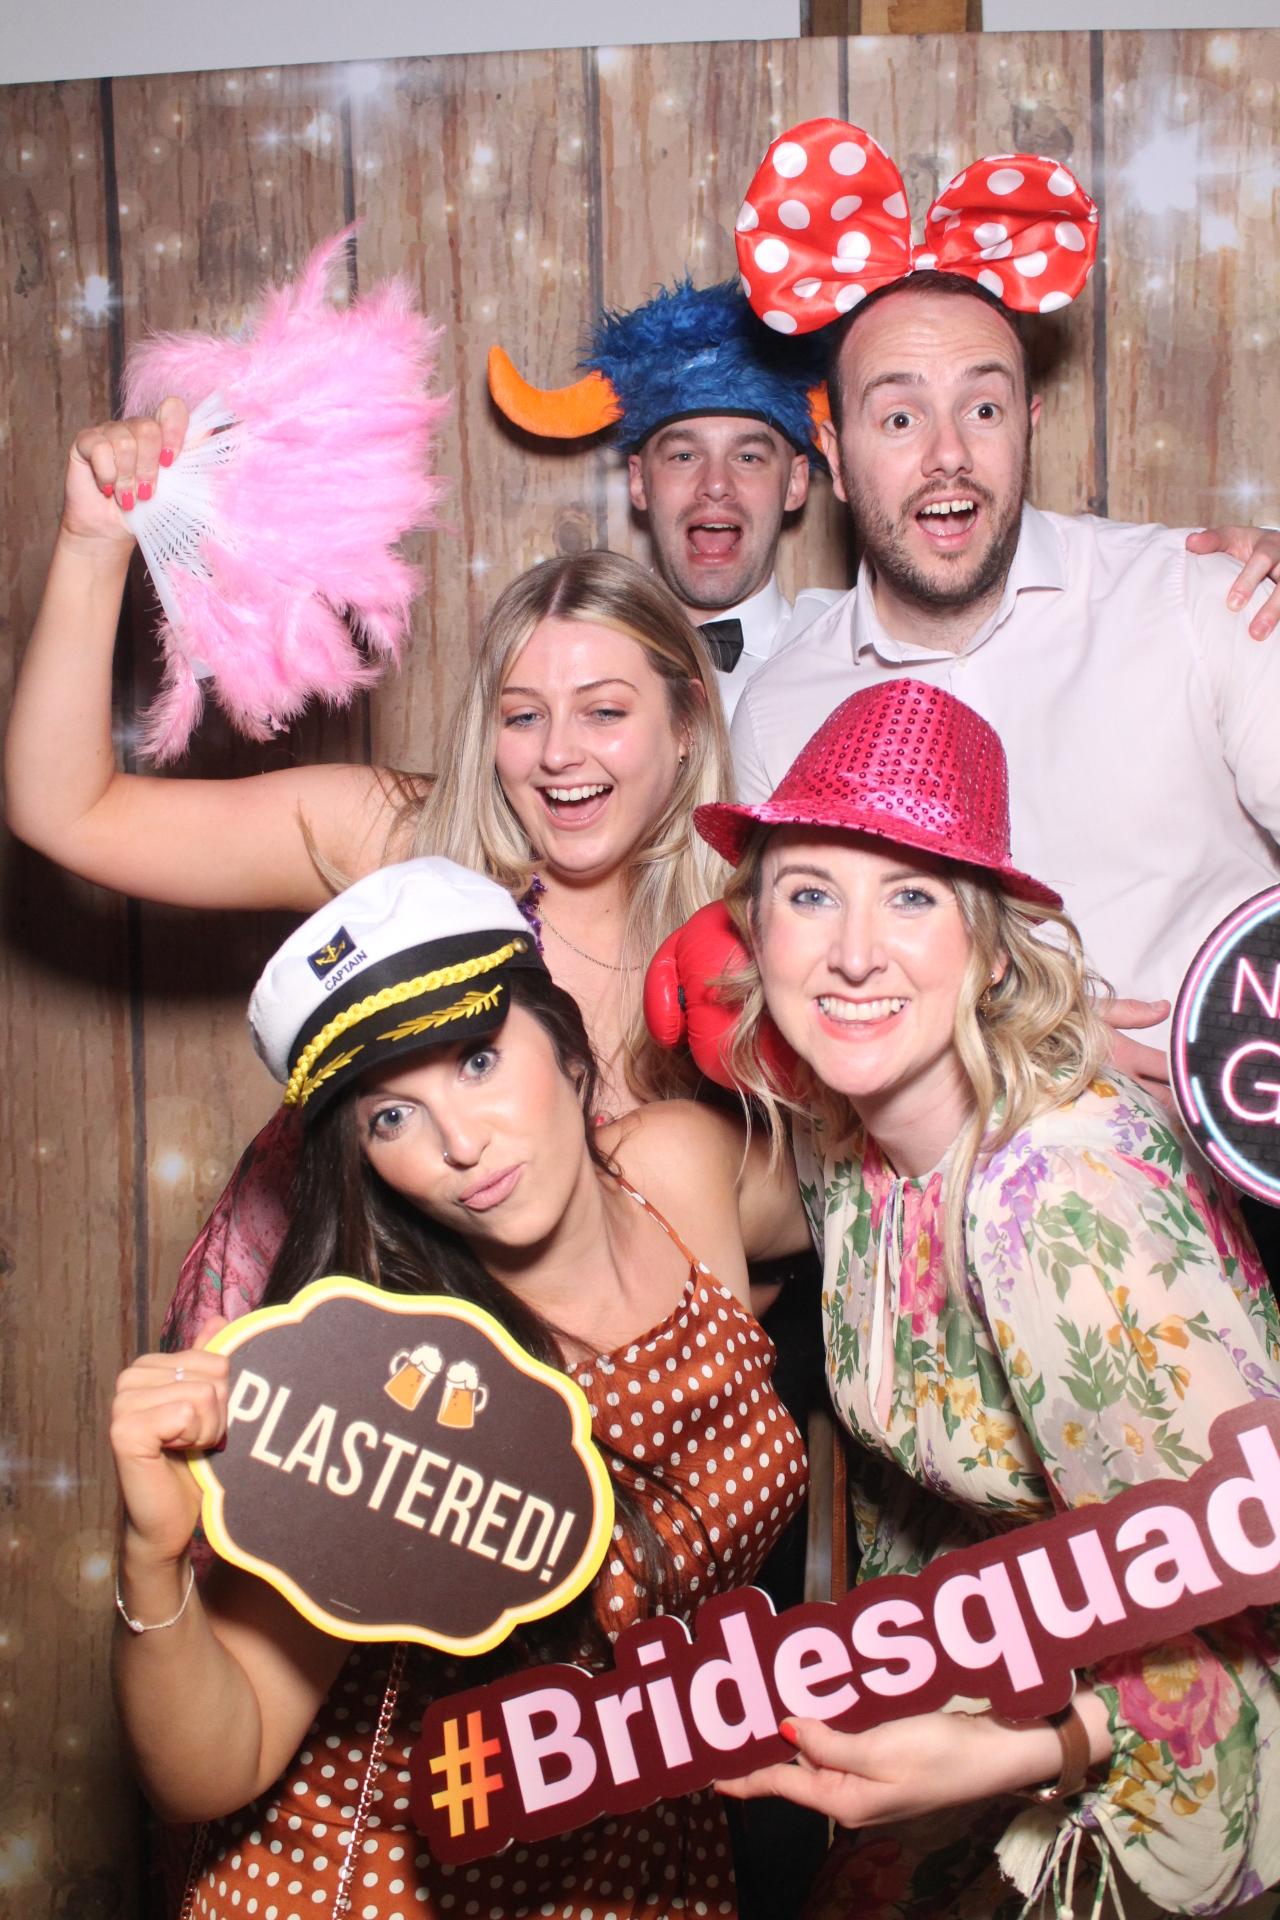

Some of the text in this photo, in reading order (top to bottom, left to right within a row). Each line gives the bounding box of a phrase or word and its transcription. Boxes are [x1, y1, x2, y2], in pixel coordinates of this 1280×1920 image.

[324, 950, 368, 991] CAPTAIN
[227, 1369, 576, 1583] PLASTERED!
[429, 1424, 1280, 1838] #Bridesquad
